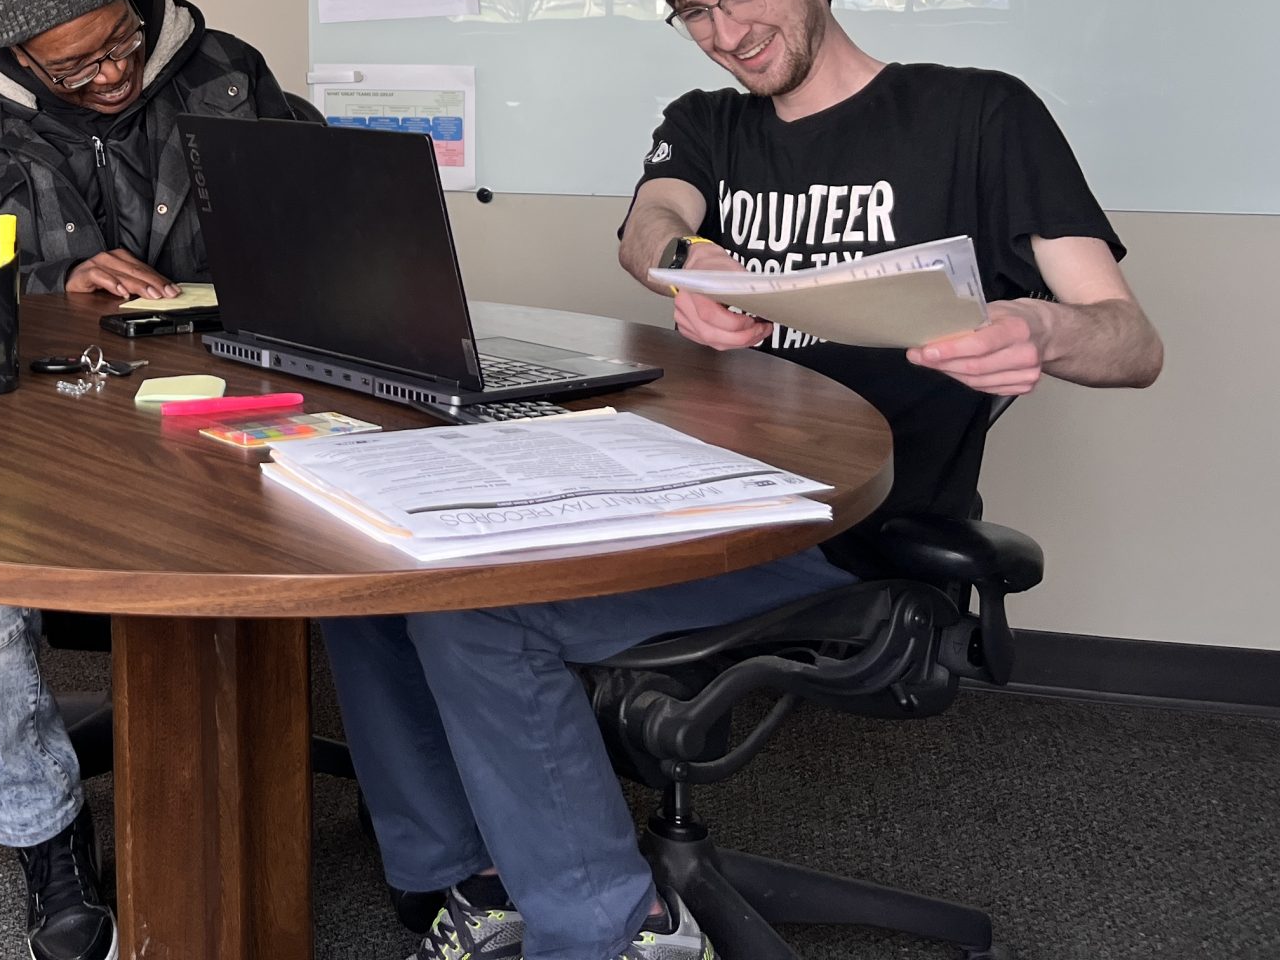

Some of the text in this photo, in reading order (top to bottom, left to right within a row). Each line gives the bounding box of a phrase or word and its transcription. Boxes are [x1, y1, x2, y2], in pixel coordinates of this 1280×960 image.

[186, 133, 213, 213] LEGION
[601, 485, 723, 507] IMPORTANT
[439, 507, 553, 527] RECORDS
[551, 500, 596, 515] TAX
